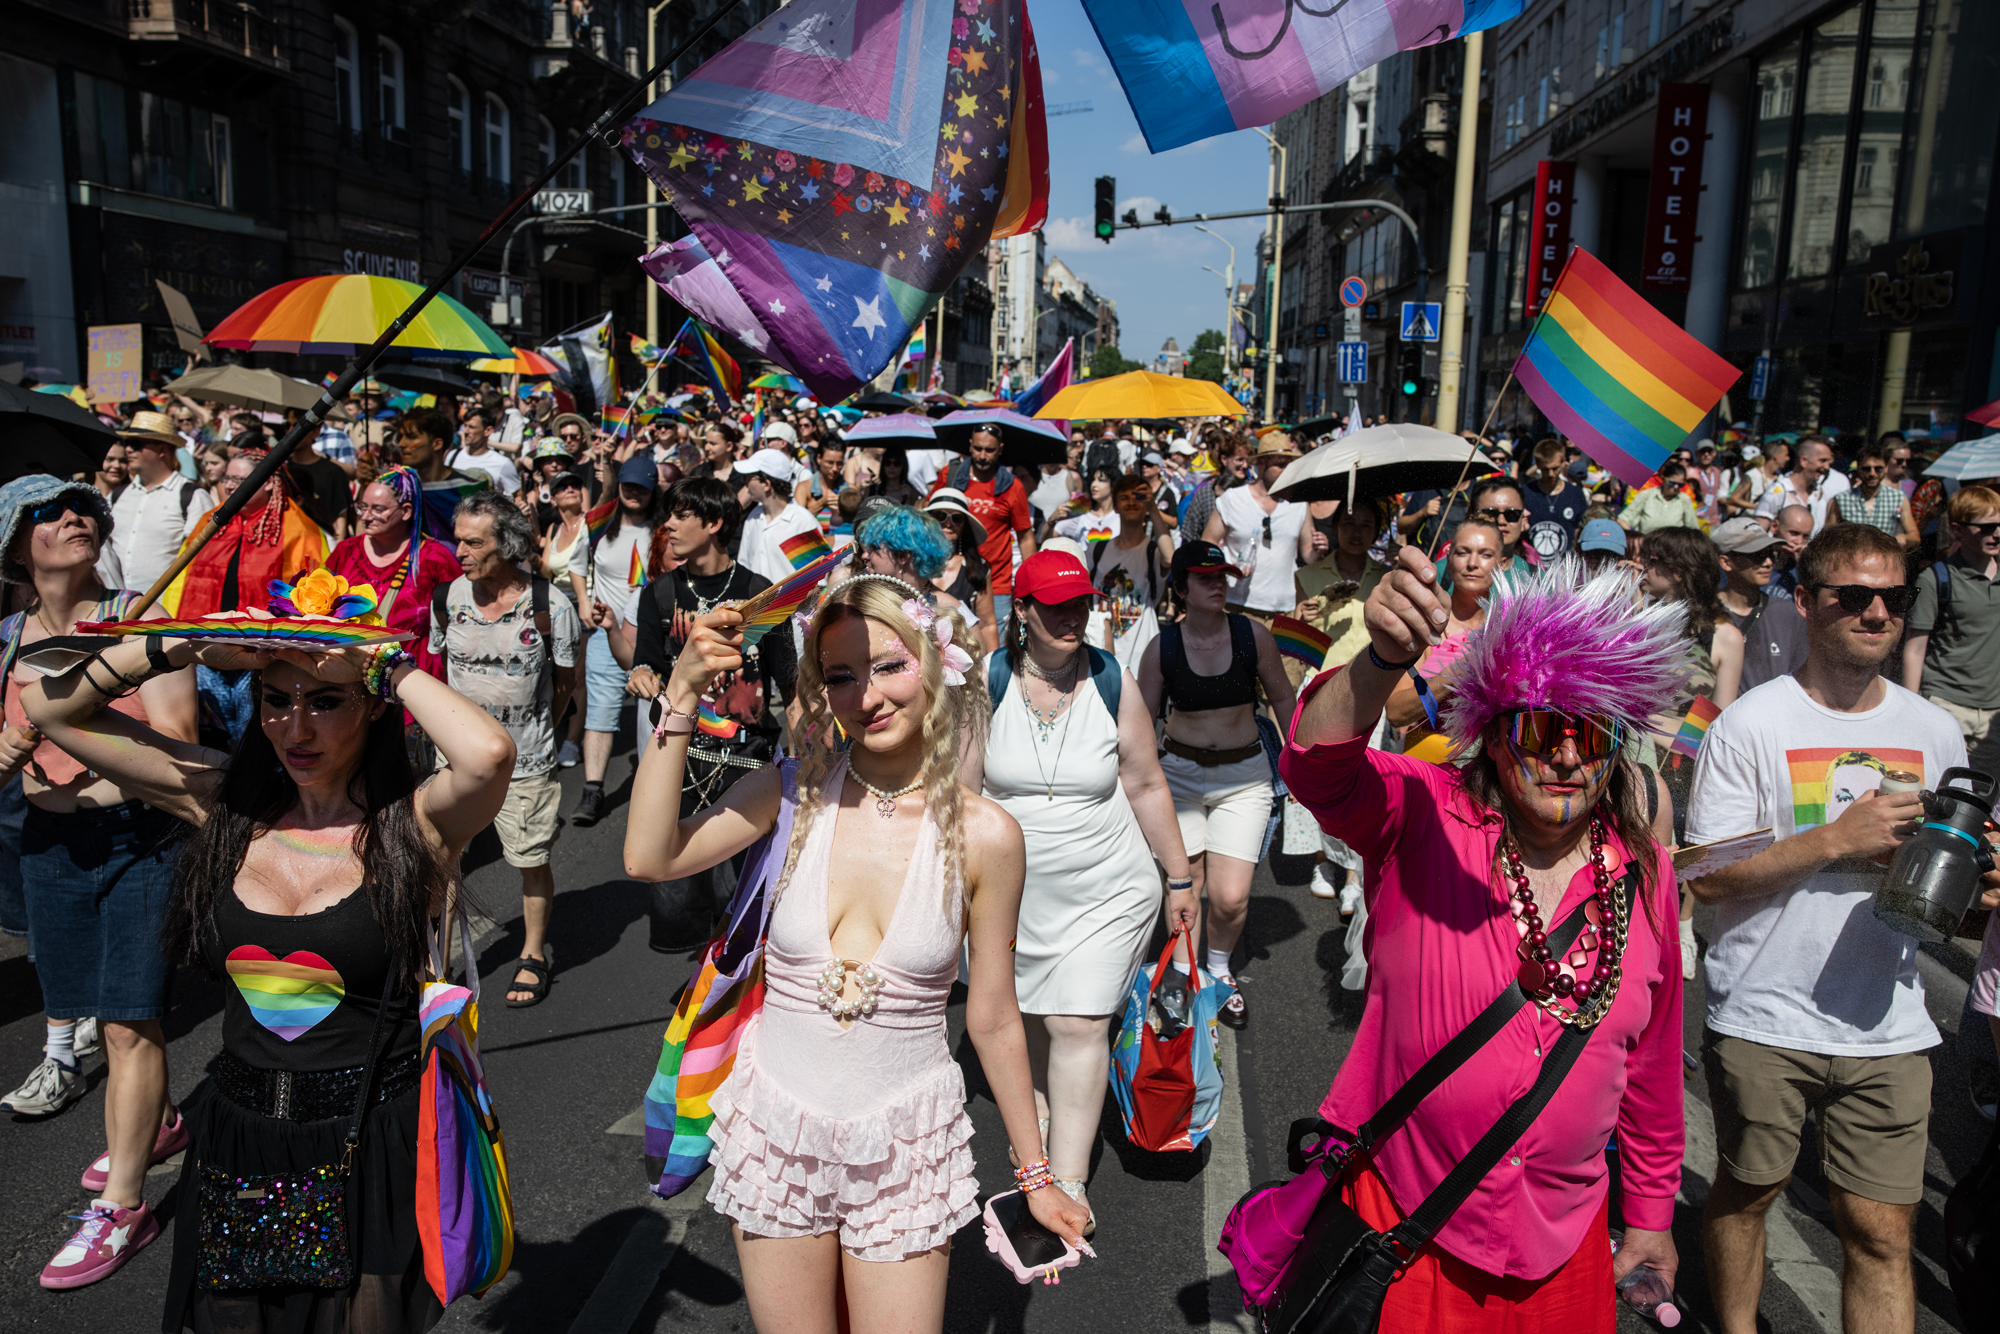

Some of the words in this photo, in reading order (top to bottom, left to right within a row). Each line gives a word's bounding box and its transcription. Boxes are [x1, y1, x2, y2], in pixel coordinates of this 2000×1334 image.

[537, 191, 584, 211] MOZI
[1663, 107, 1692, 244] HOTEL
[1542, 179, 1563, 282] HOTEL
[105, 352, 123, 368] IS
